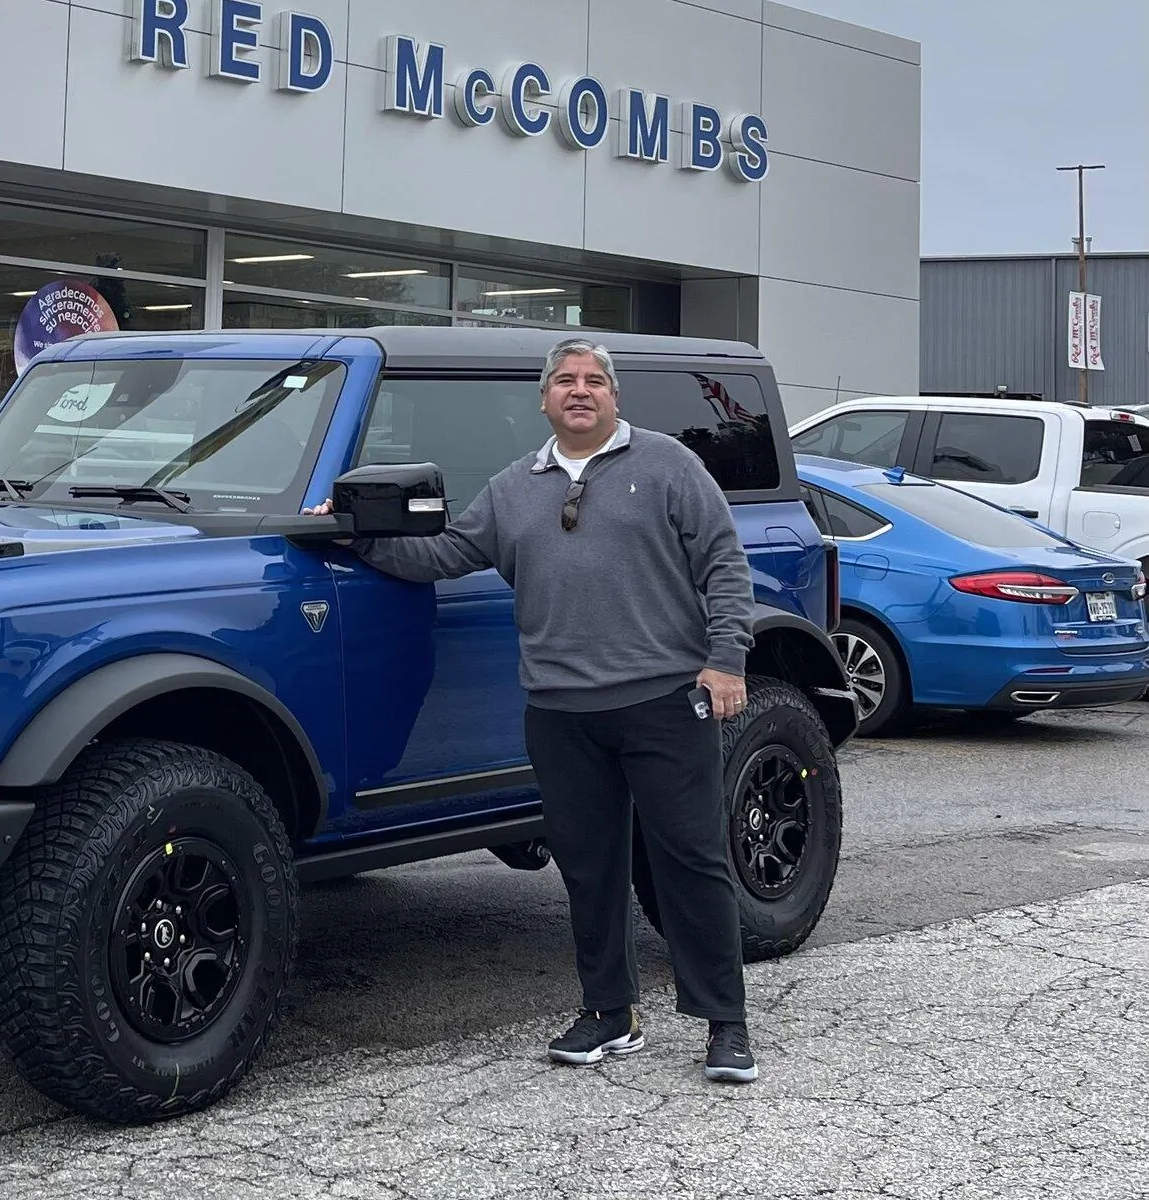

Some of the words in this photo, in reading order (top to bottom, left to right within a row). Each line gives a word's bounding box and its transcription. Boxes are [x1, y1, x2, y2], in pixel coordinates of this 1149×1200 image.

[38, 286, 104, 318] Agradecemos
[39, 300, 101, 332] sinceramente
[45, 319, 57, 334] su
[58, 311, 91, 333] negoci
